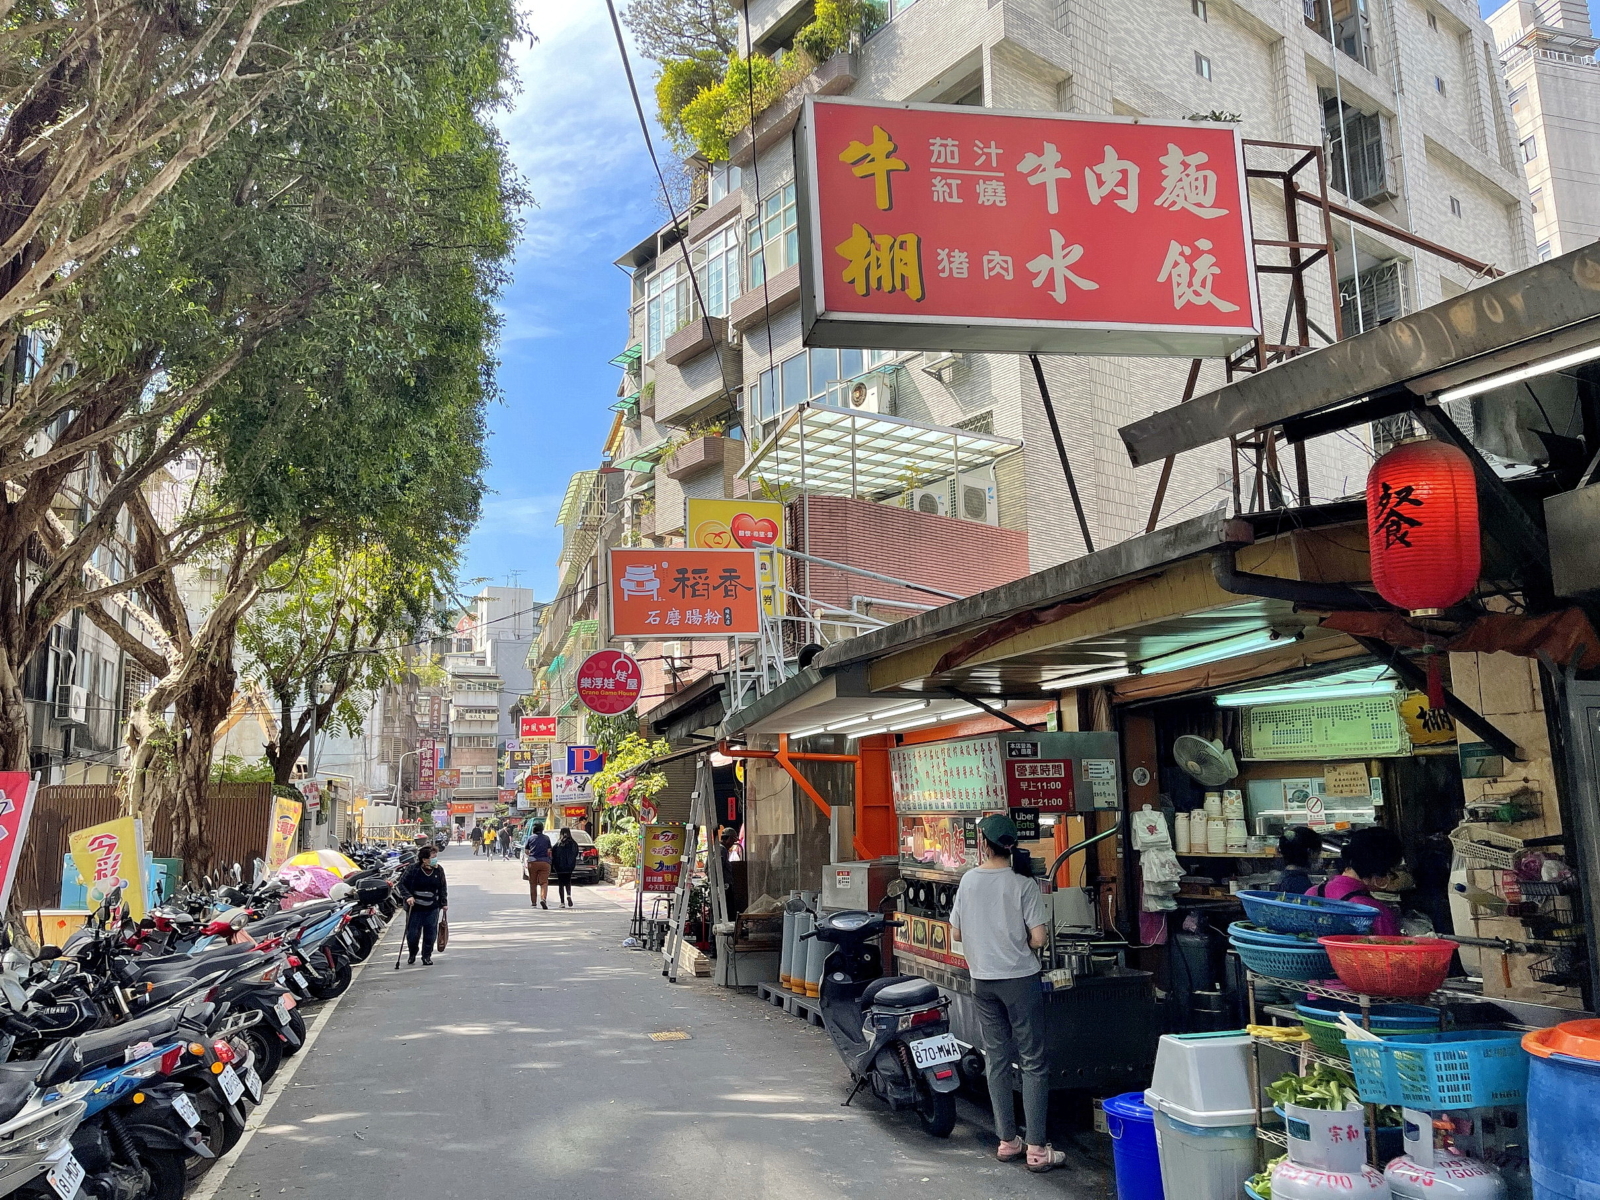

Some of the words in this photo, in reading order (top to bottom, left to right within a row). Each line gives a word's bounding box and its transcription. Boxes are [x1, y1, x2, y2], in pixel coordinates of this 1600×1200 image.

[929, 137, 1004, 168] 茄汁
[931, 177, 1007, 207] 紅燒
[1016, 140, 1229, 220] 牛肉麵
[835, 125, 925, 302] 牛棚
[1026, 228, 1240, 313] 水餃
[669, 567, 754, 600] 稻香
[644, 607, 722, 626] 石磨腸粉
[570, 748, 599, 773] P
[1016, 764, 1063, 777] 營業時間
[1020, 781, 1062, 790] 早上11:00
[1015, 812, 1034, 820] Uber
[1016, 821, 1035, 829] Eats
[914, 1043, 960, 1064] 870-MWA
